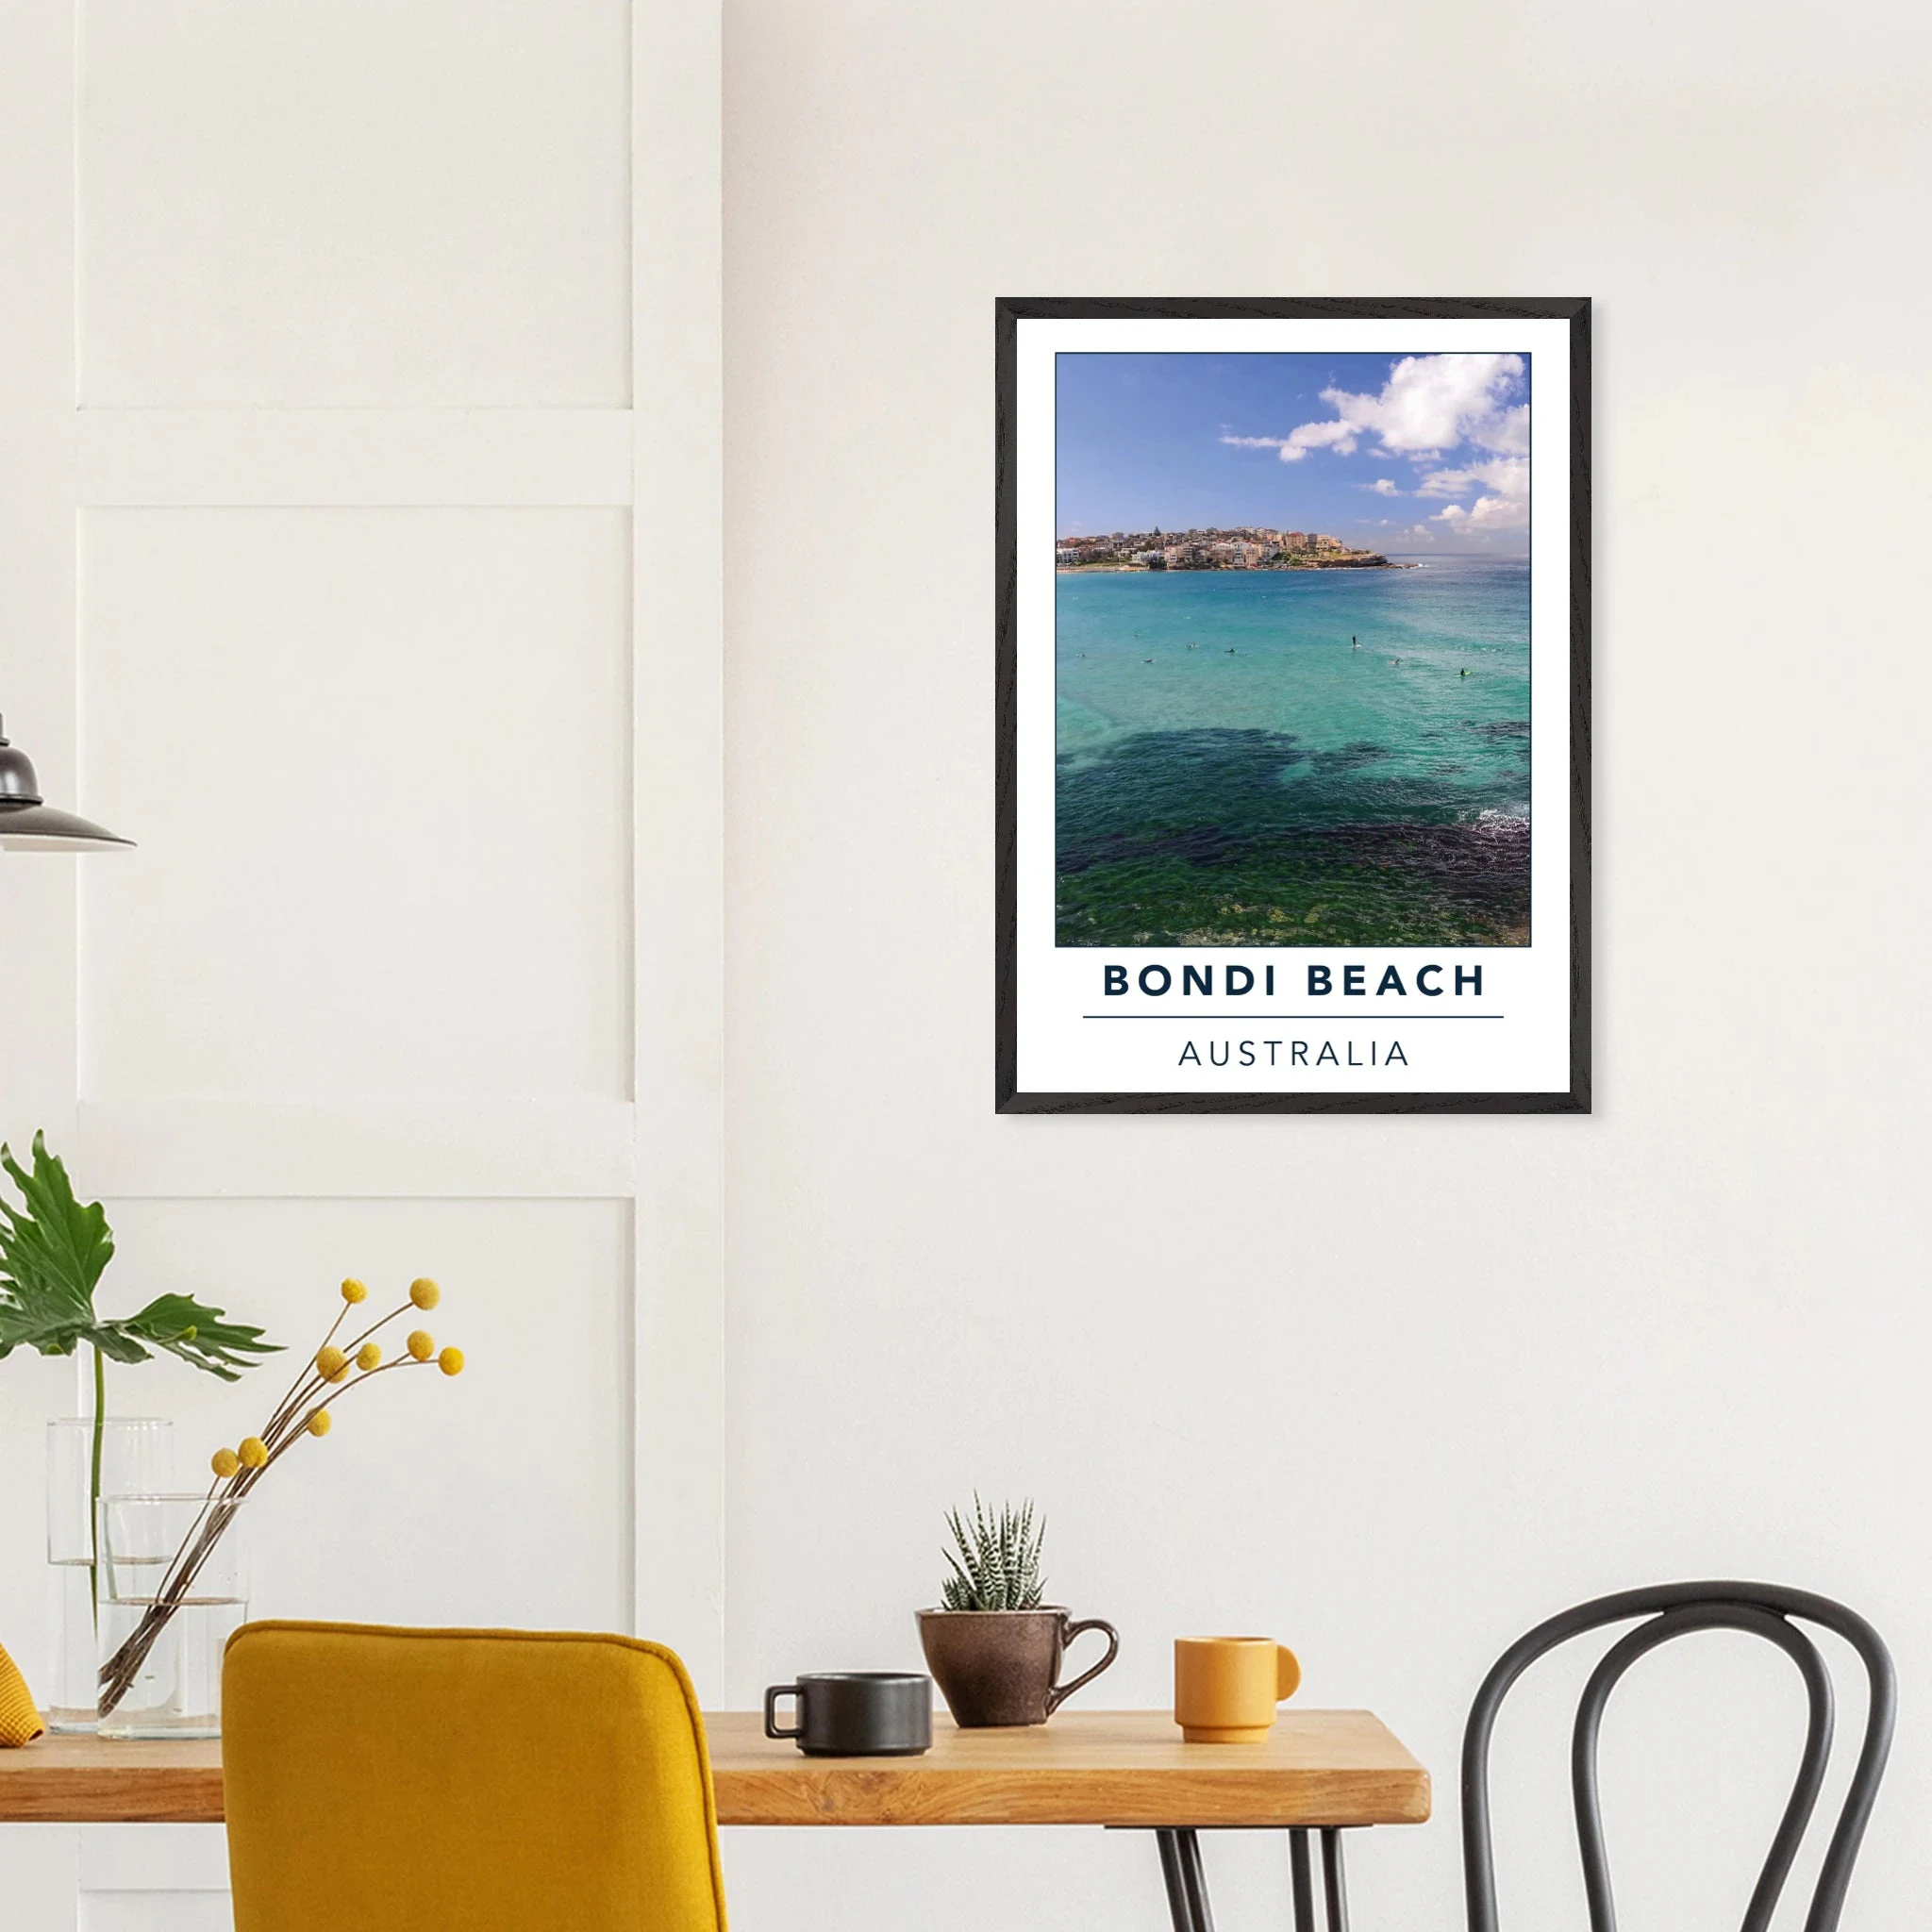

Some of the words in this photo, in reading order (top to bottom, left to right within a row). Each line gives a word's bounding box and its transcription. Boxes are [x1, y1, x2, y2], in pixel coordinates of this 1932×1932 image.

[1104, 964, 1274, 997] BONDI
[1307, 964, 1483, 997] BEACH
[1177, 1040, 1409, 1067] AUSTRALIA
